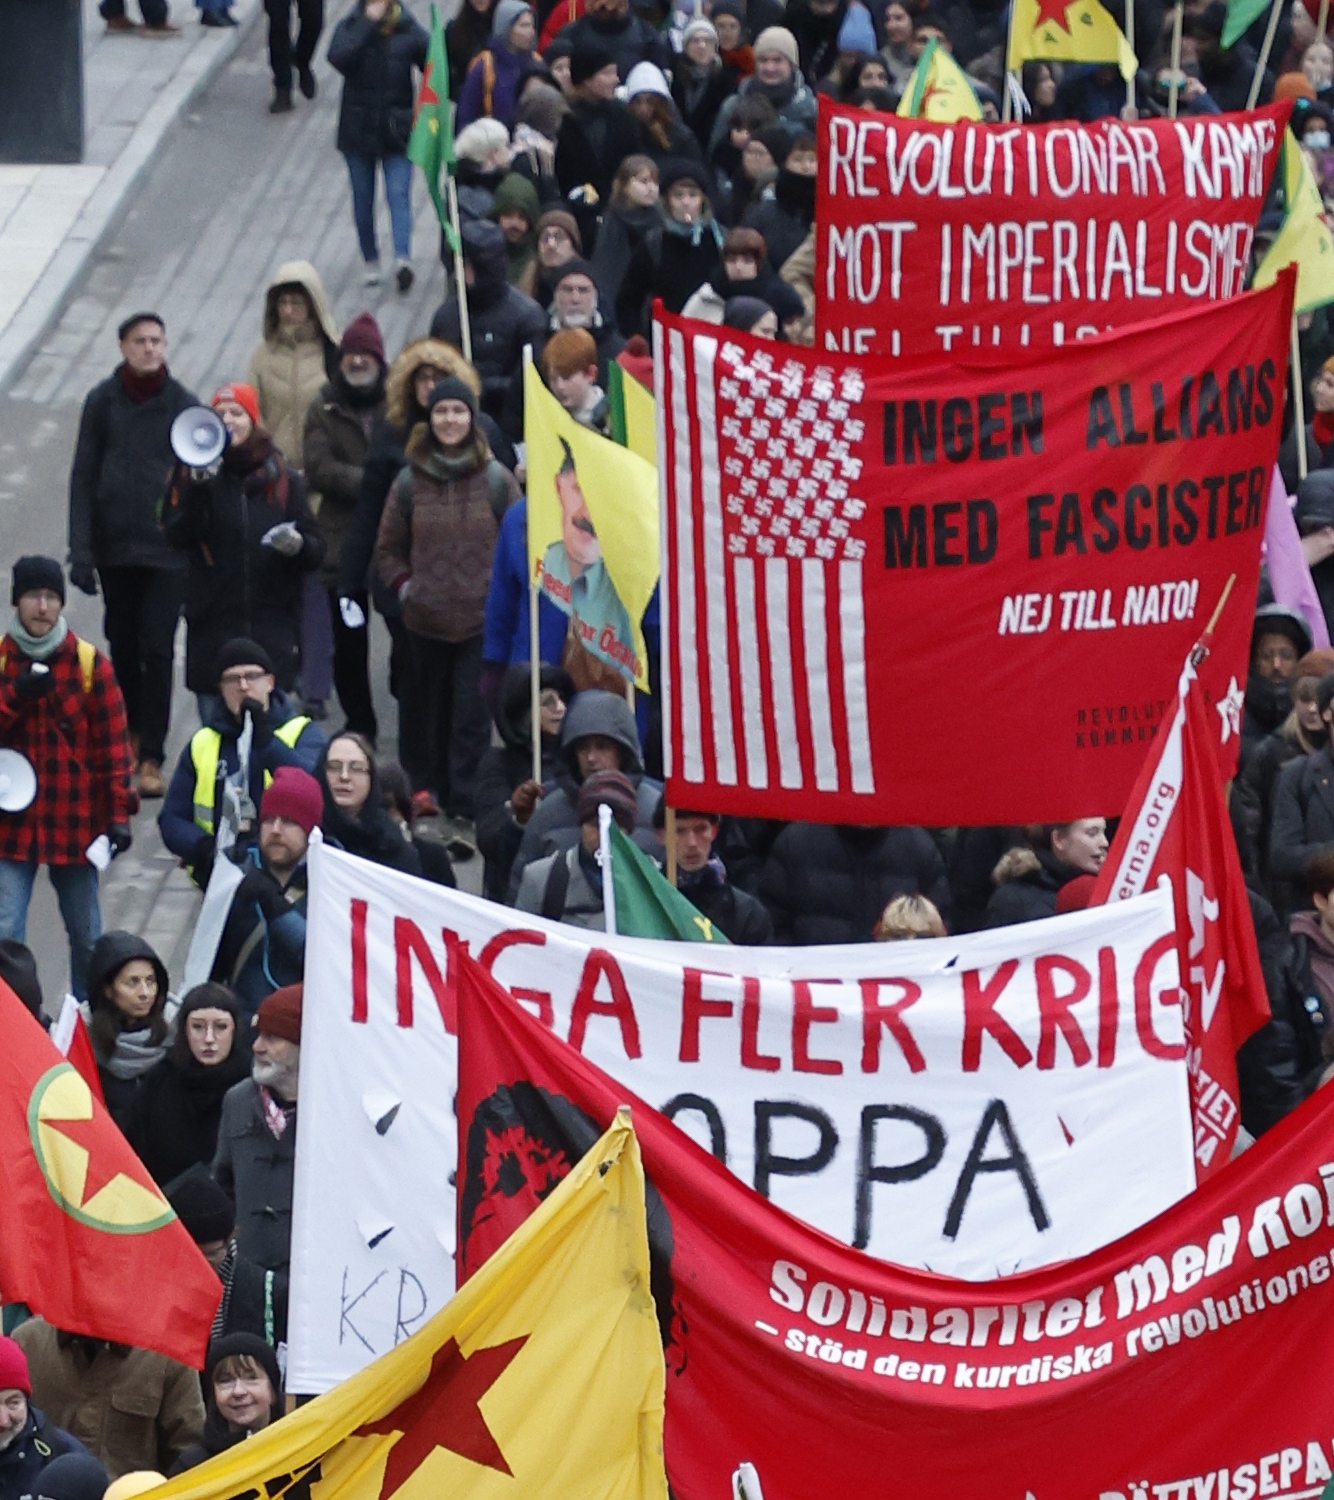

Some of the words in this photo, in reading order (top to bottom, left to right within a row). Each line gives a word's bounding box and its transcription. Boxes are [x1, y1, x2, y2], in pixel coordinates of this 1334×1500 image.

[828, 115, 1166, 199] REVOLUTIONÄR
[826, 221, 919, 305] MOT
[883, 390, 1045, 466] INGEN
[1085, 357, 1276, 450] ALLIANS
[882, 497, 999, 569] MED
[1026, 465, 1267, 560] FASCISTER
[998, 594, 1053, 636] NEJ
[1060, 587, 1117, 631] TILL
[1121, 577, 1200, 627] NATO!
[677, 964, 928, 1076] FLER
[960, 930, 1187, 1073] KRIG
[661, 1092, 1052, 1250] OPPA
[336, 1264, 431, 1356] KR
[768, 1258, 1107, 1350] Solidaritet
[1111, 1214, 1240, 1314] med
[784, 1325, 867, 1372] stöd
[872, 1350, 947, 1386] den
[953, 1341, 1113, 1389] kurdiska
